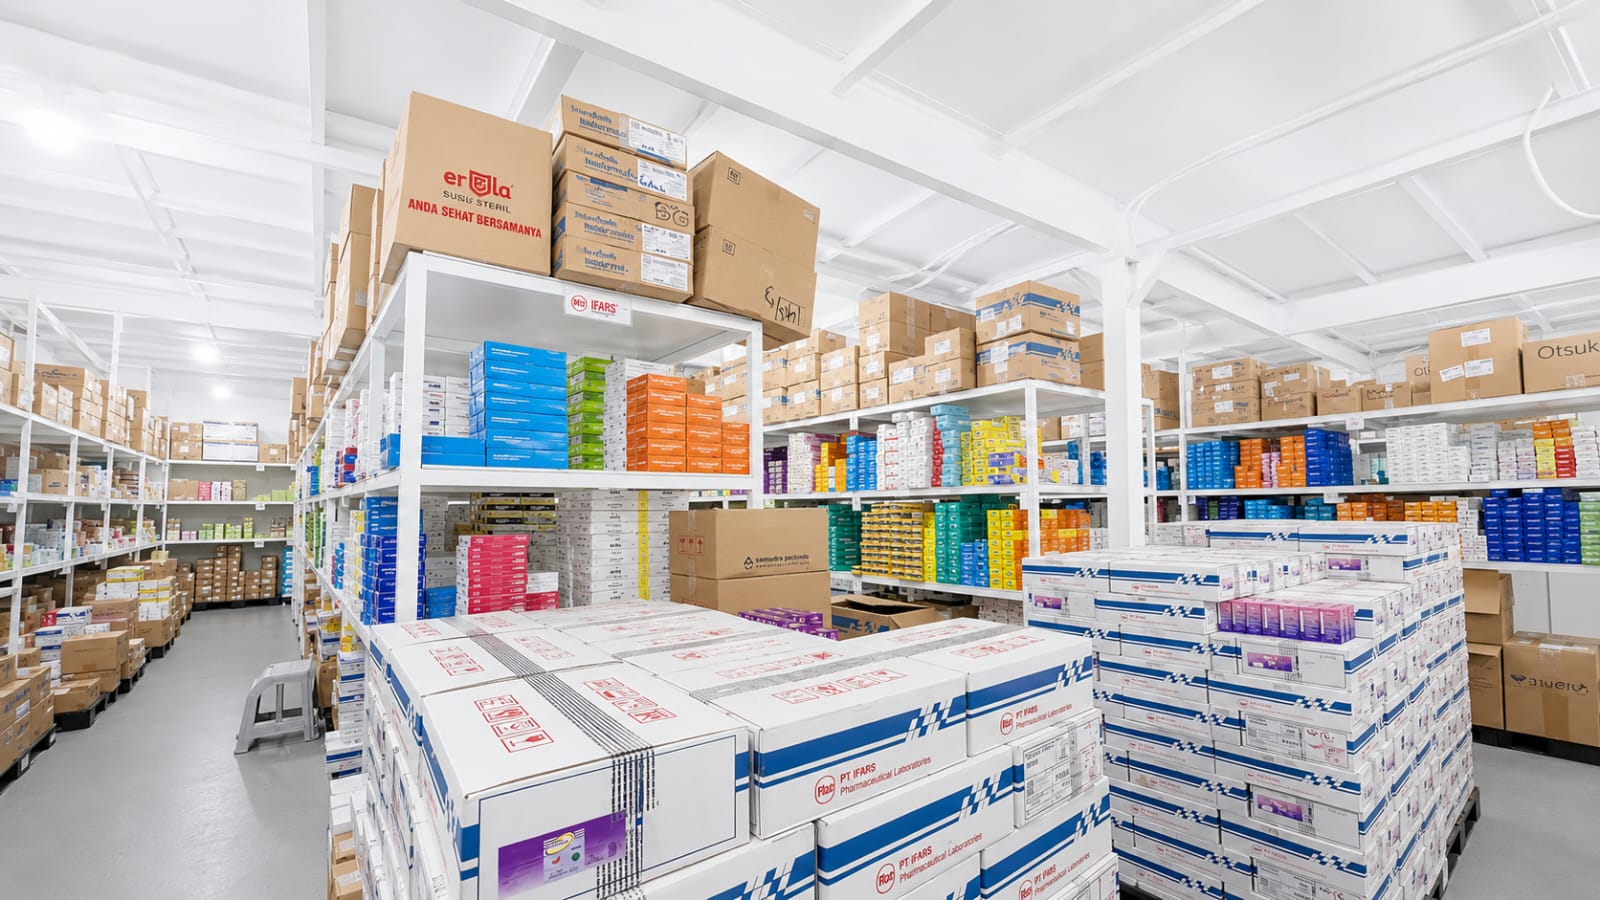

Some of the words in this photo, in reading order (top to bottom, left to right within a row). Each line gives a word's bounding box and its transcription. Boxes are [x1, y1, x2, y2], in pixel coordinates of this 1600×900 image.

[408, 198, 438, 215] ANDA
[441, 206, 474, 223] SEHAT
[476, 214, 542, 238] BERSAMANYA
[591, 299, 616, 314] IFARS
[840, 771, 851, 784] PT
[853, 763, 877, 779] IFARS
[840, 770, 892, 797] Pharmaceutical
[893, 756, 932, 777] Laboratories
[899, 857, 909, 870] PT
[911, 845, 933, 865] IFARS
[899, 850, 947, 884] Pharmaceutical
[947, 833, 983, 857] Laboratories
